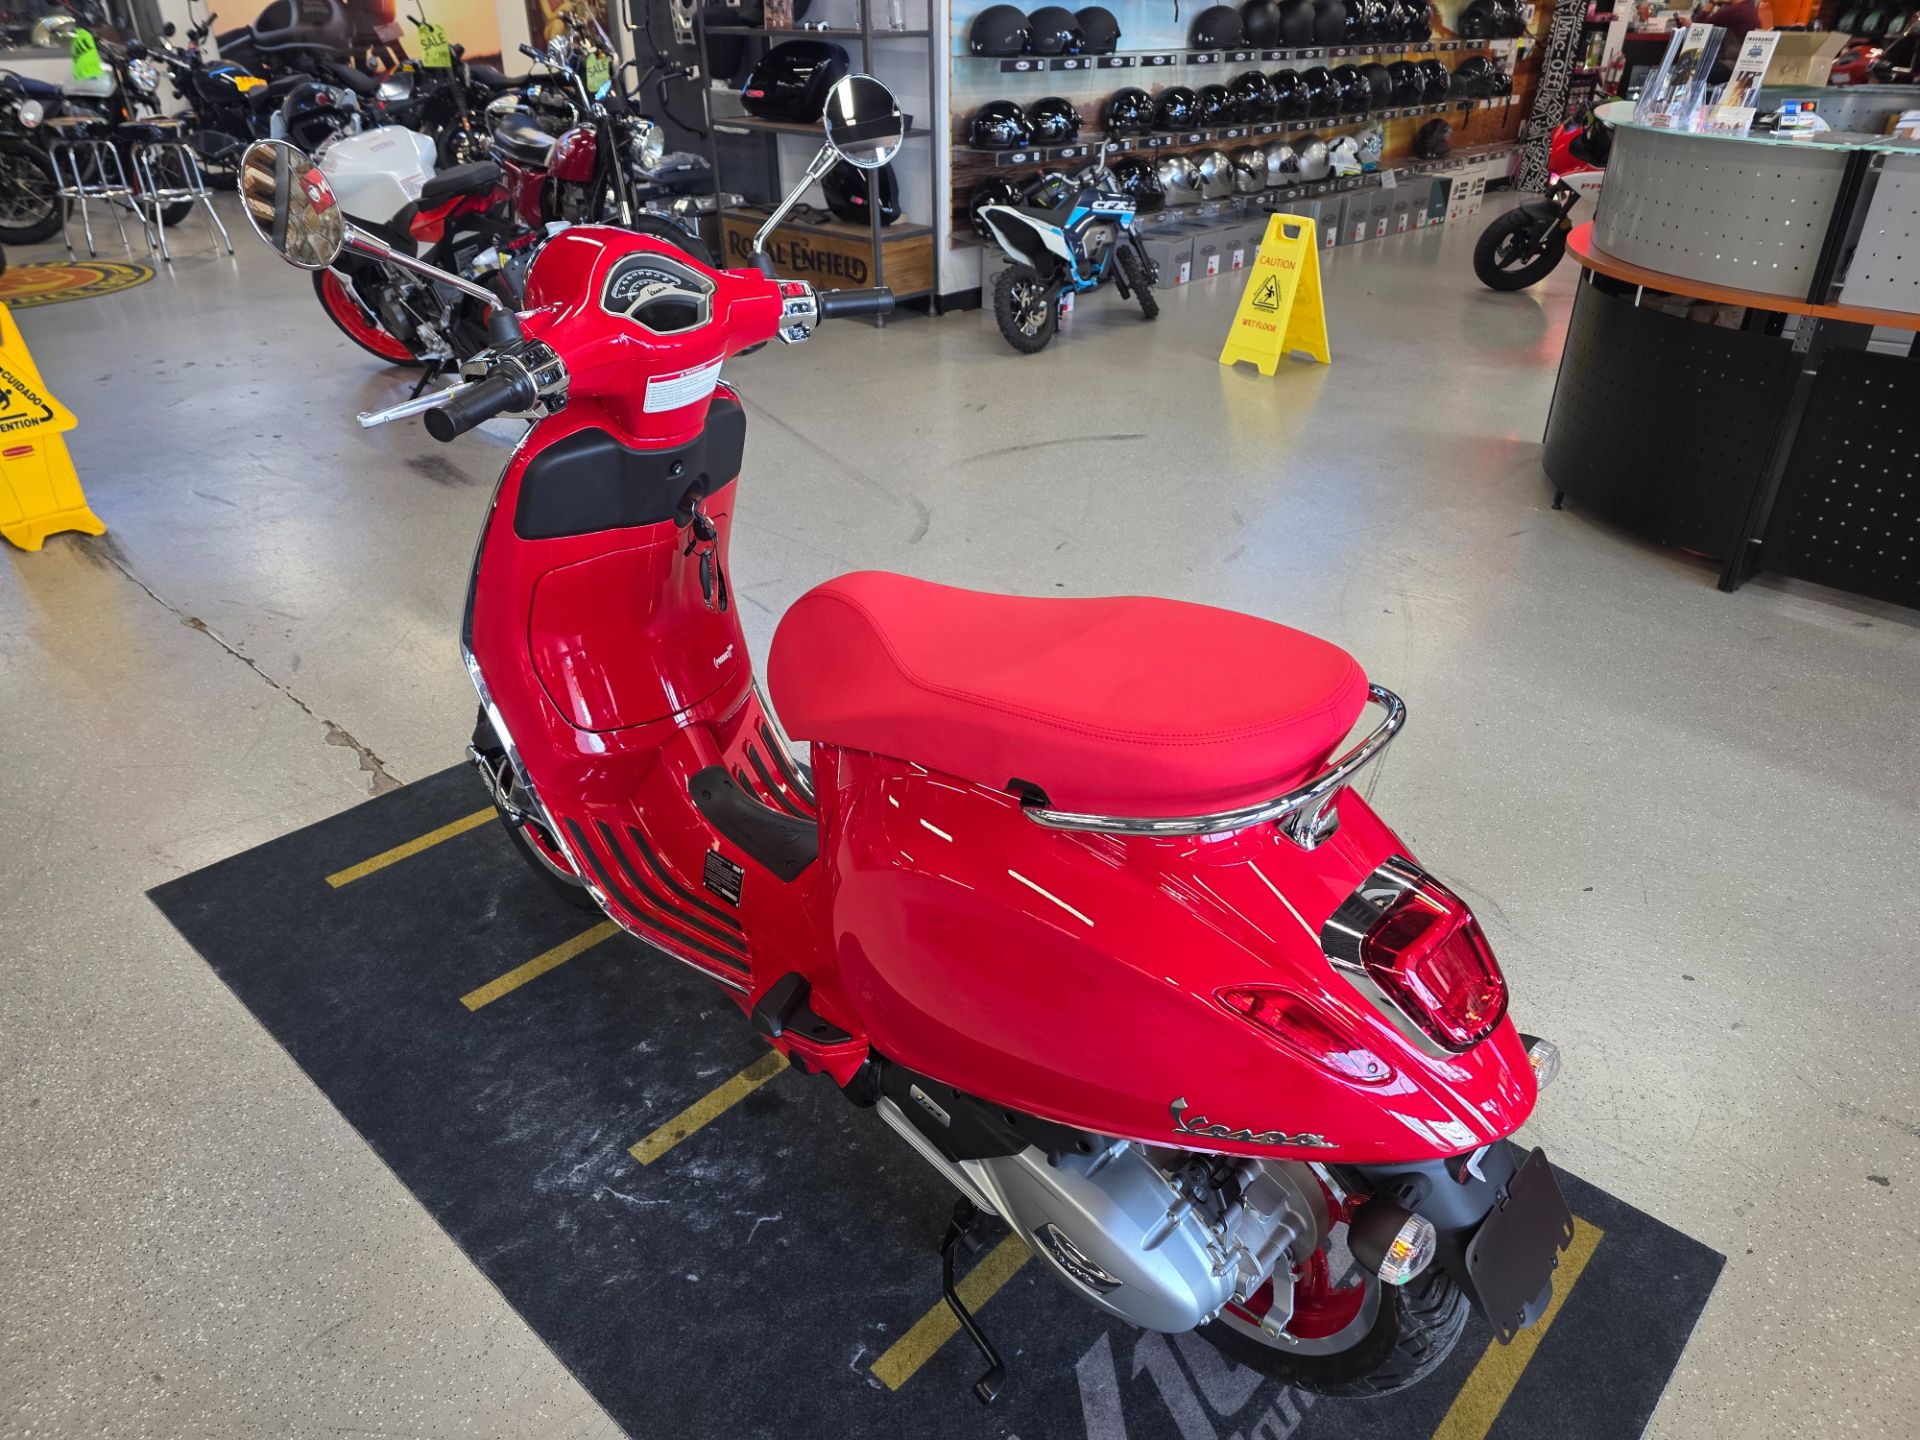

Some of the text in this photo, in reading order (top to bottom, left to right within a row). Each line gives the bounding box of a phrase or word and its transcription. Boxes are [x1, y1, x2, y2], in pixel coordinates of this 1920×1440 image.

[420, 32, 447, 51] SALE
[1550, 18, 1573, 90] Muc-Off
[588, 62, 607, 77] SALE
[729, 230, 867, 284] ROAL ENFIELD
[1259, 255, 1296, 271] CAUTION
[1242, 318, 1277, 333] WET FLOOR
[2, 371, 42, 406] CUIDADO
[0, 416, 40, 433] ENTION
[1170, 1096, 1340, 1149] Vespa
